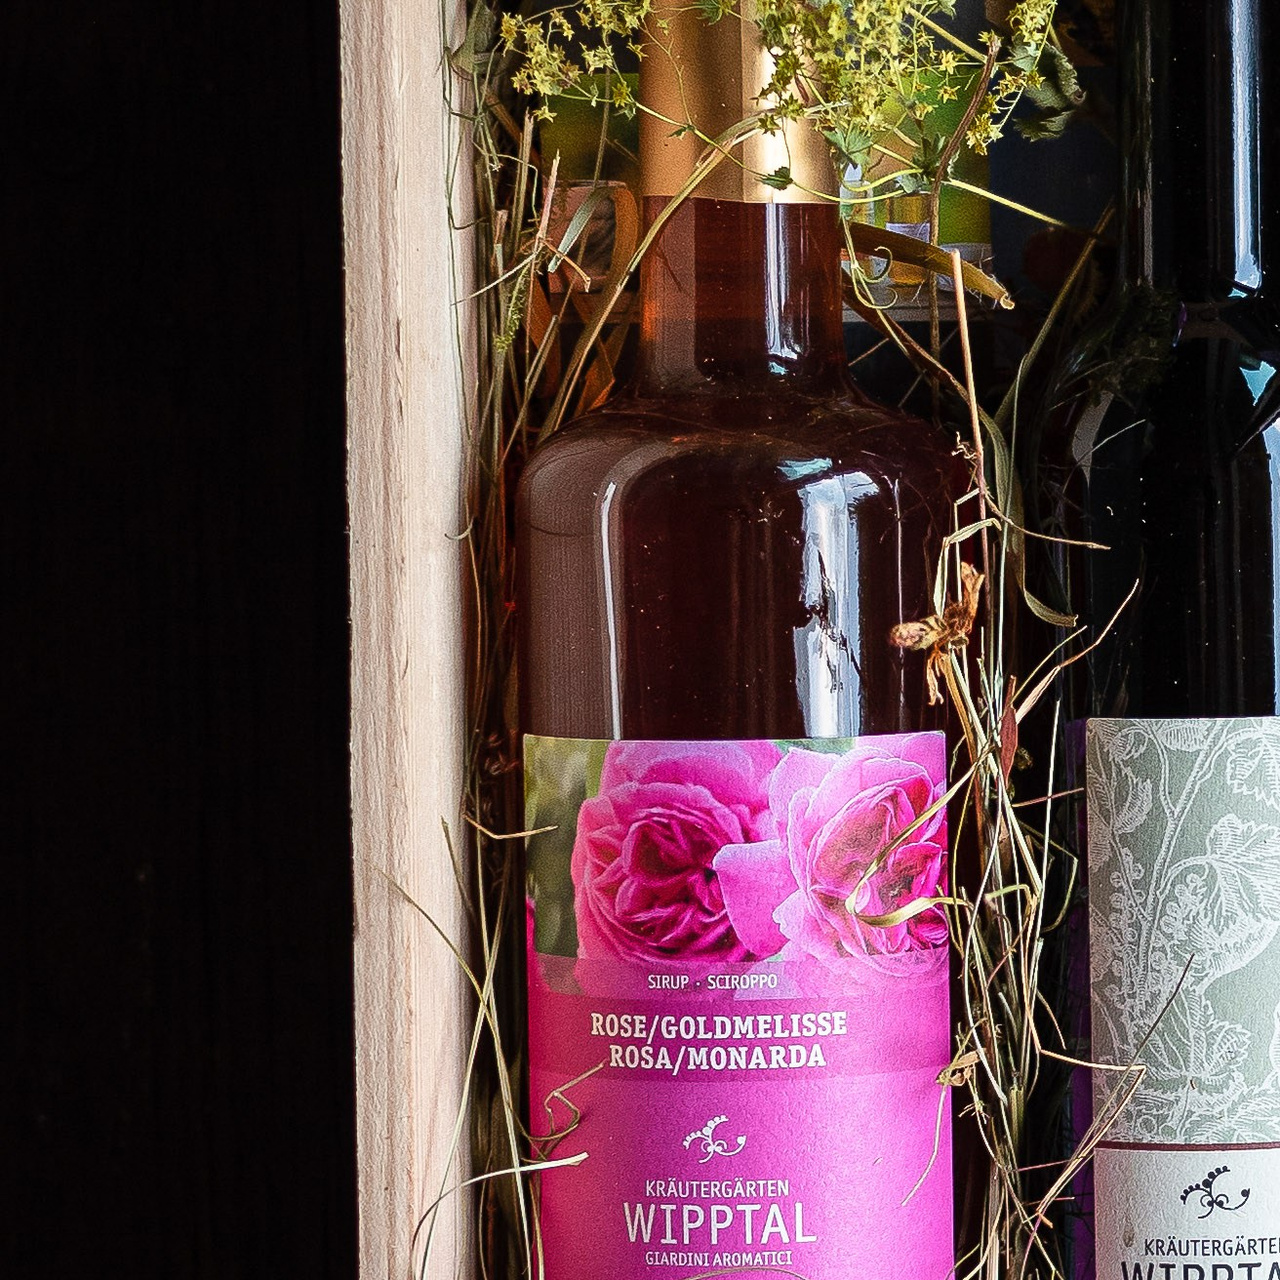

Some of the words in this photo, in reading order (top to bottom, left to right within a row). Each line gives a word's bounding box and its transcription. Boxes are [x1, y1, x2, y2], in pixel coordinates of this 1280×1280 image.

[647, 973, 689, 990] SIRUP
[707, 972, 778, 990] SCIROPPO
[591, 1010, 847, 1044] ROSE/GOLDMELISSE
[609, 1043, 826, 1076] ROSA/MONARDA
[645, 1175, 789, 1198] KRÄUTERGÄRTEN
[623, 1202, 818, 1245] WIPPTAL
[645, 1250, 709, 1266] GIARDINI
[713, 1249, 792, 1266] AROMATICI
